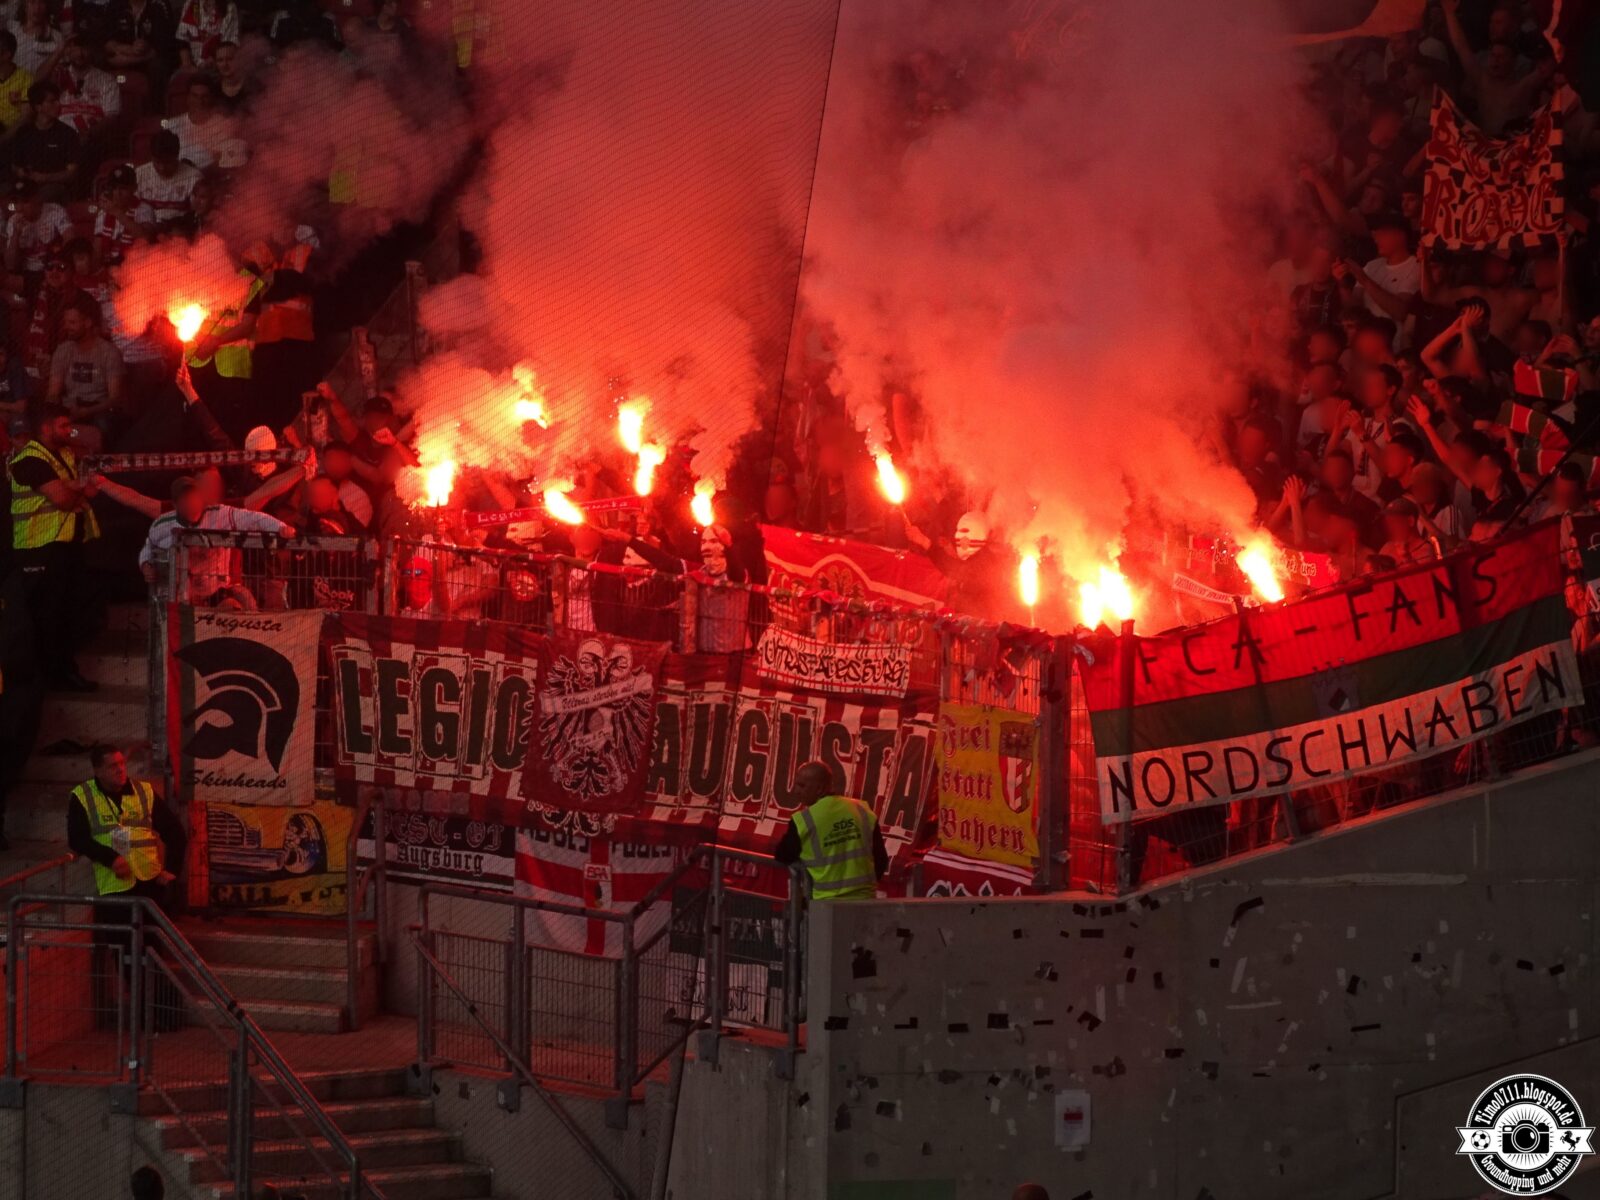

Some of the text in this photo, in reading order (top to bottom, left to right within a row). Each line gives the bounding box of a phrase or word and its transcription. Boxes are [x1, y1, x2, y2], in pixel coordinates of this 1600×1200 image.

[195, 613, 283, 633] Augusta
[1136, 615, 1267, 685] FCA
[1346, 551, 1498, 642] FANS
[338, 658, 929, 831] LEGIO AUGUSTA
[941, 714, 992, 758] Frei
[1107, 651, 1567, 813] NORDSCHWABEN
[187, 769, 287, 790] Skinheads
[832, 818, 856, 832] SDS
[941, 807, 1026, 854] Bayern
[397, 841, 484, 877] Augsburg
